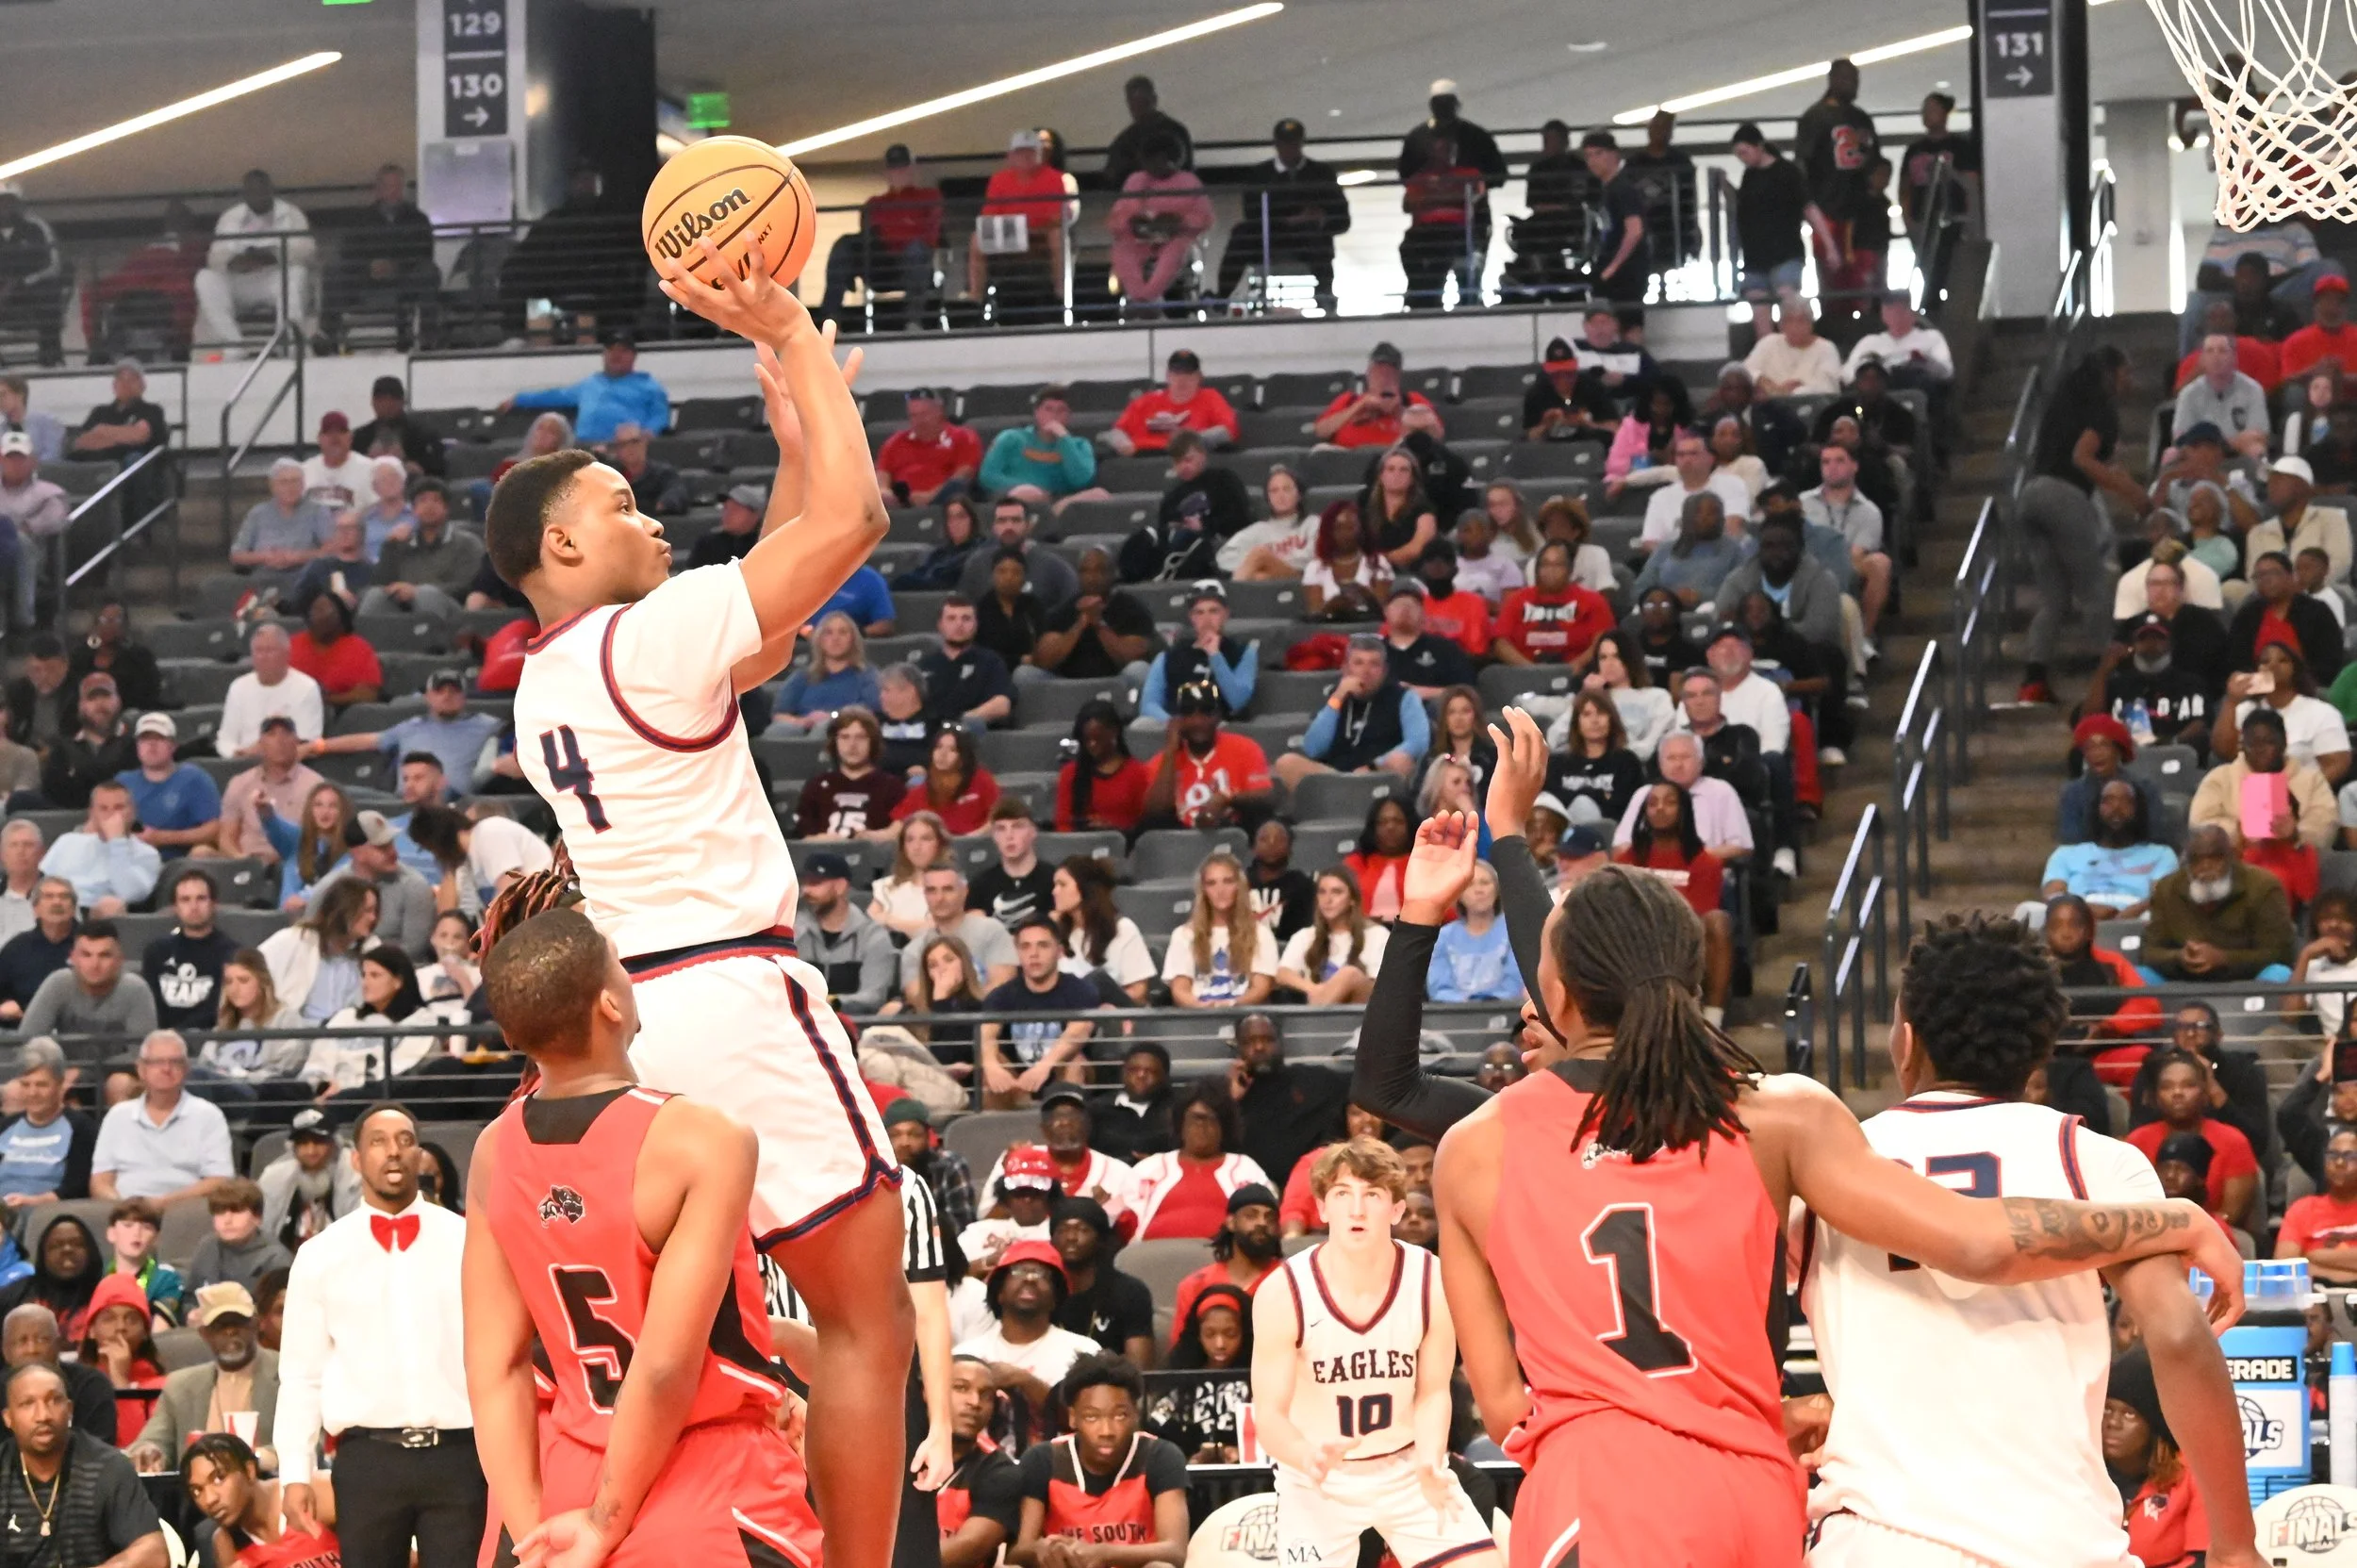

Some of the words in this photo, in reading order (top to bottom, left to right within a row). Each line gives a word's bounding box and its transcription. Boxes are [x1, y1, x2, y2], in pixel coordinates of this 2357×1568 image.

[450, 11, 502, 36] 129
[1995, 31, 2044, 57] 131
[449, 73, 503, 98] 130
[654, 188, 750, 259] Wilson
[757, 222, 773, 245] NXT
[538, 724, 612, 834] 4
[1579, 1201, 1698, 1378] 1
[548, 1263, 637, 1414] 5
[1312, 1349, 1414, 1384] EAGLES
[1336, 1393, 1393, 1438] 10
[1093, 1523, 1146, 1543] SOUTH
[1287, 1544, 1322, 1565] MA
